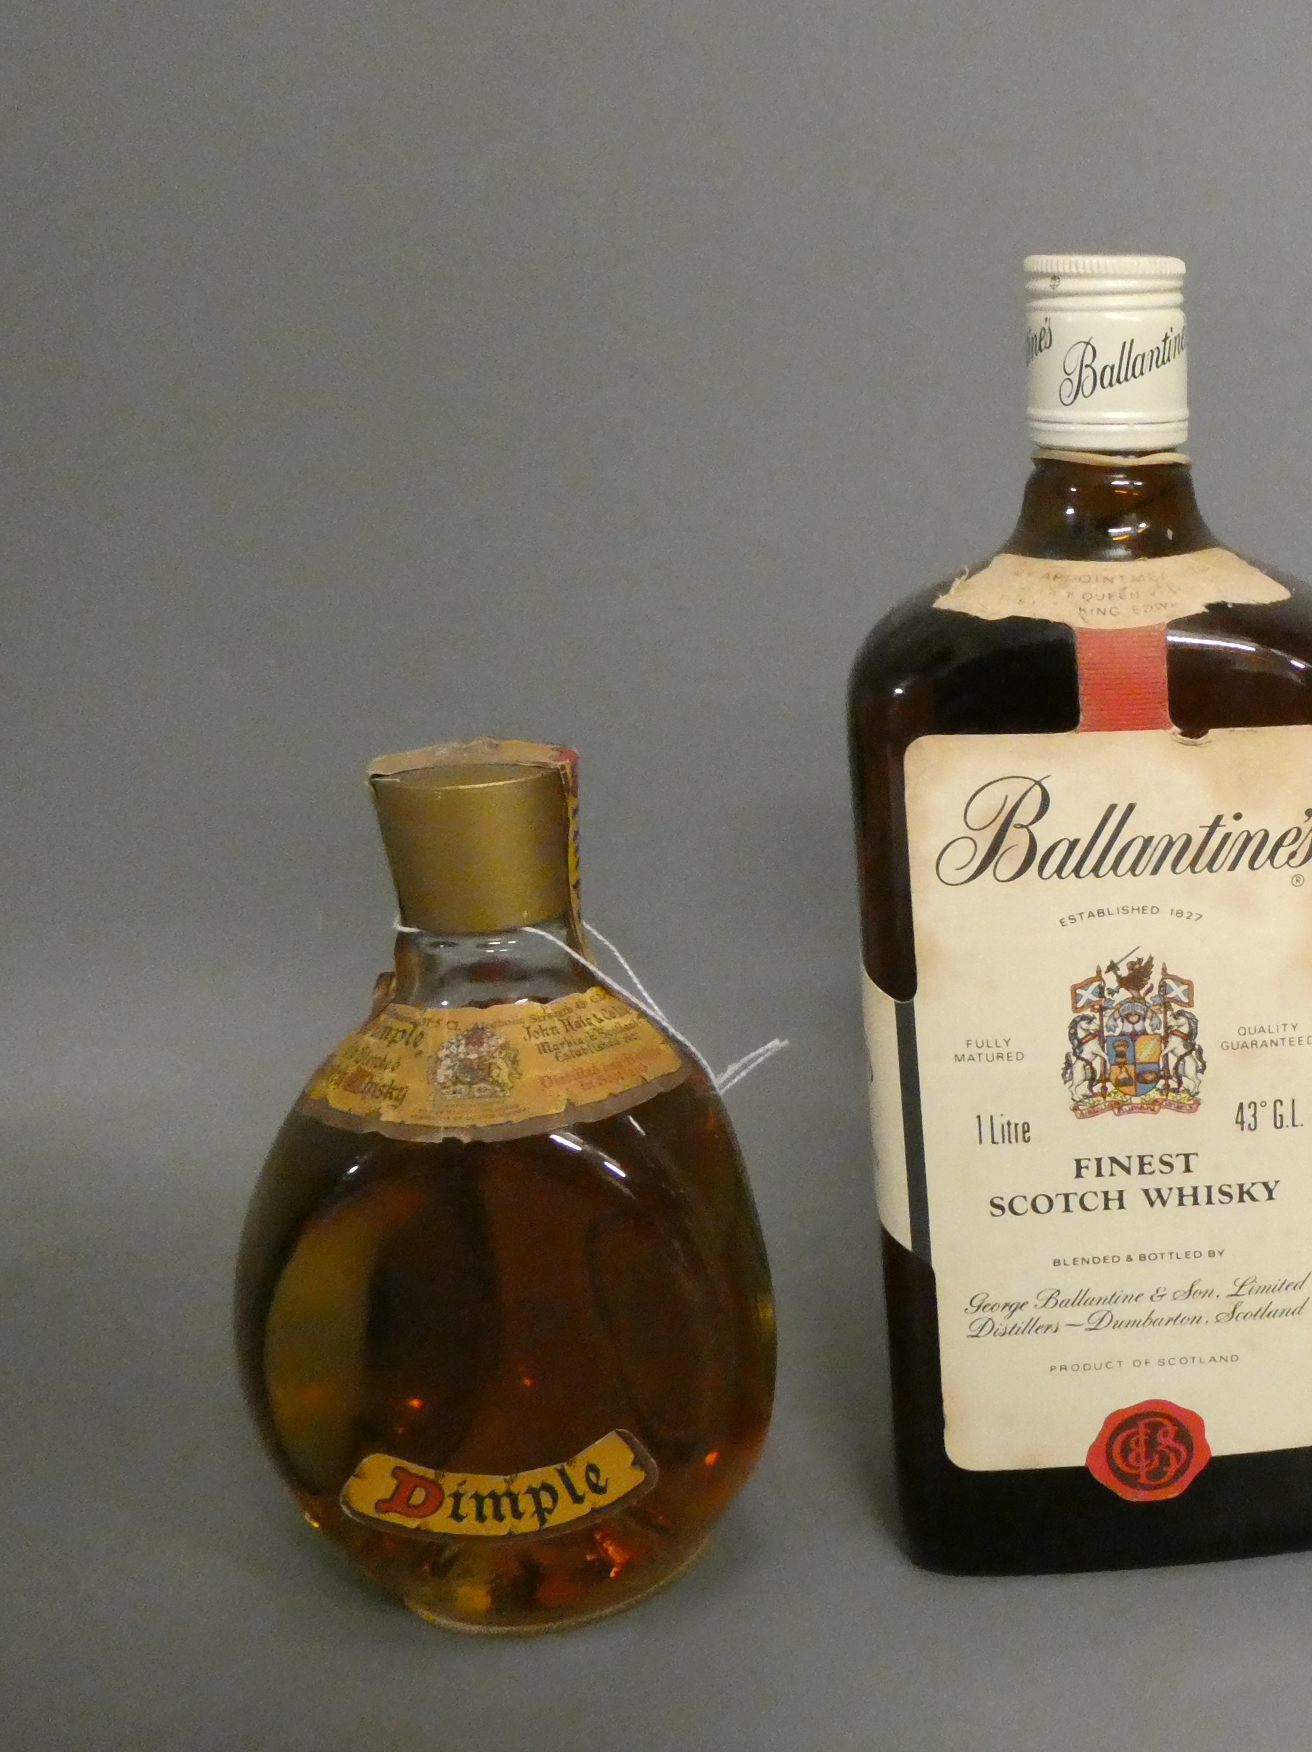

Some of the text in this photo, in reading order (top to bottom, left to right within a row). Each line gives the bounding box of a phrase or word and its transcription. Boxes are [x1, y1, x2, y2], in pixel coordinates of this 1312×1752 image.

[1058, 904, 1204, 928] ESTABLISHED 1827
[965, 1037, 1012, 1050] FULLY
[1236, 1022, 1300, 1037] QUALITY
[953, 1049, 1026, 1064] MATURED
[1272, 1098, 1304, 1130] G.L.
[975, 1113, 1032, 1146] 1 Litre
[1073, 1151, 1200, 1180] FINEST
[988, 1179, 1282, 1219] SCOTCH WHISKY
[1052, 1248, 1226, 1267] BLENDED & BOTTLED BY
[963, 1291, 1031, 1320] George
[1034, 1286, 1146, 1312] Ballantine
[1149, 1286, 1167, 1302] &
[1225, 1271, 1312, 1299] Limited
[965, 1317, 1061, 1339] Distillers
[1214, 1297, 1311, 1324] Scotland
[1050, 1353, 1240, 1373] PRODUCT OF SCOTLAND
[374, 1461, 610, 1529] Dimple
